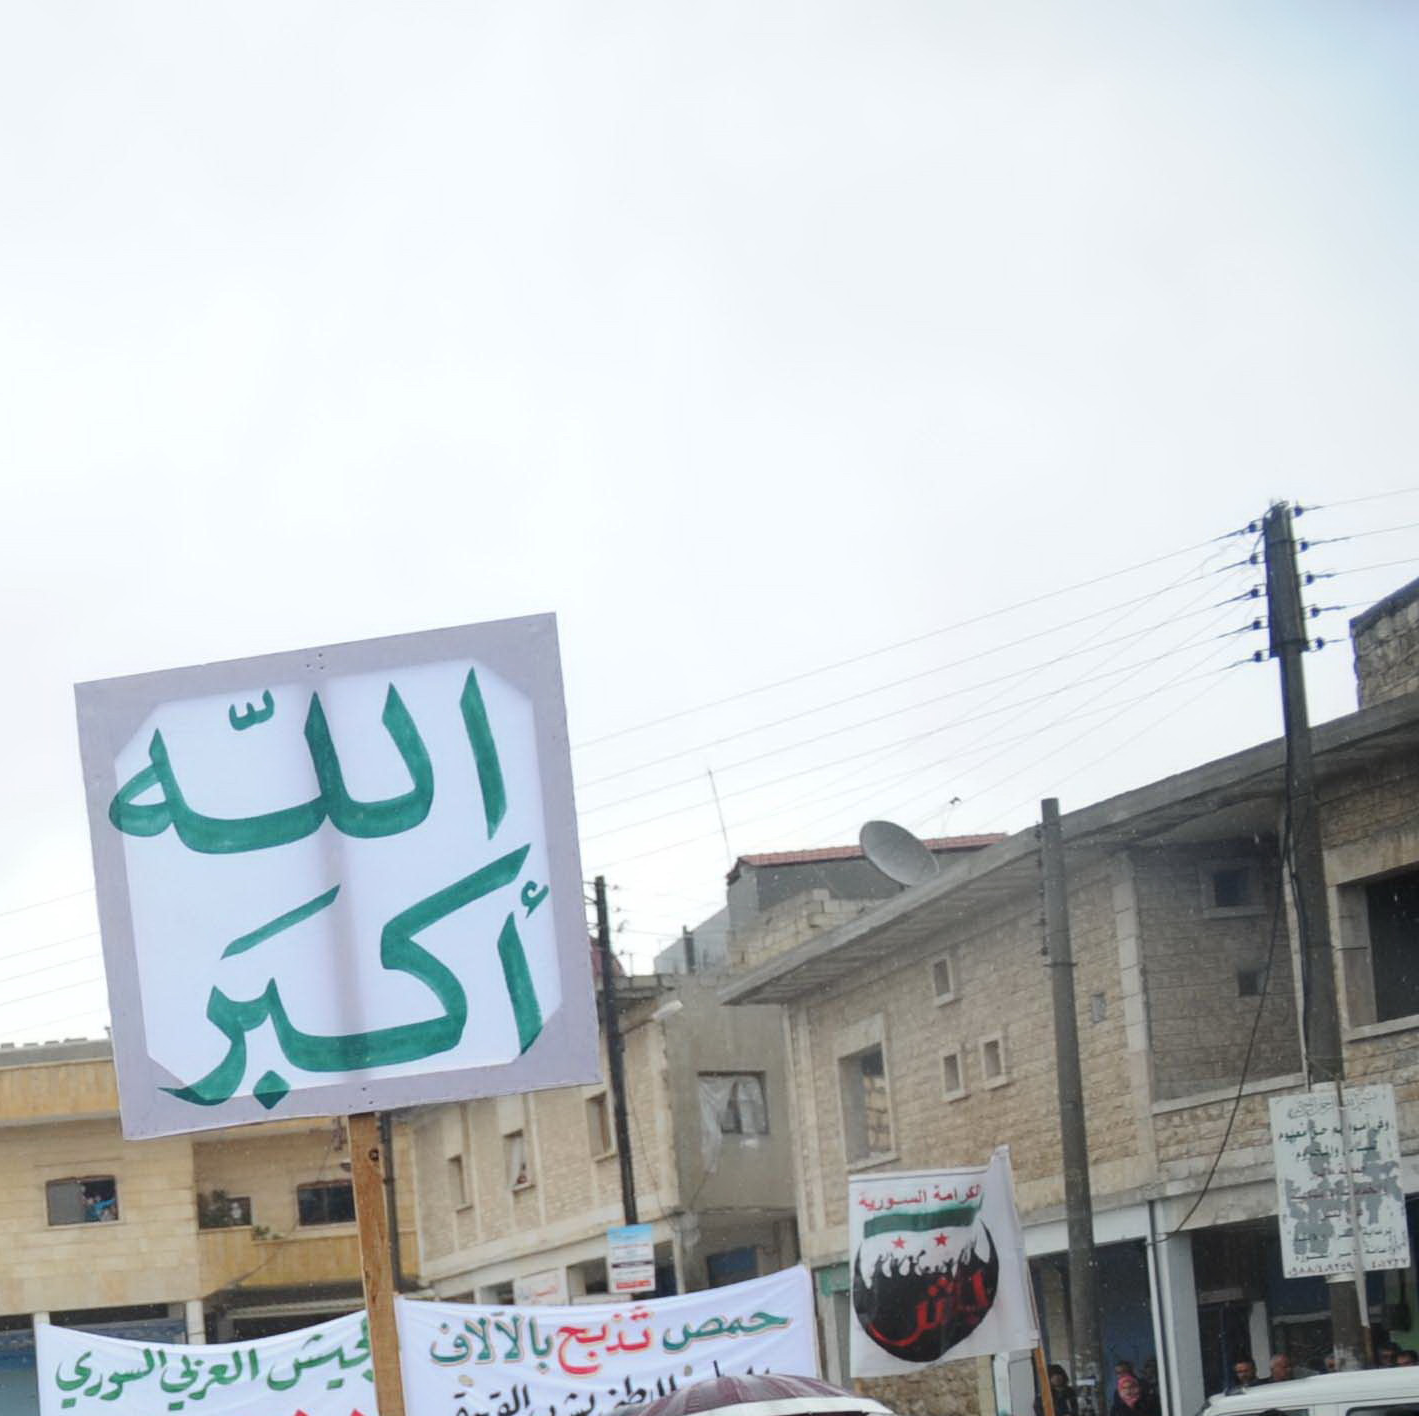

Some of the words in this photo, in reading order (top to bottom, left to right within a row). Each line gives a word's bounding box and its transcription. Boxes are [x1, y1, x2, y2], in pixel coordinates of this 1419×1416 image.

[108, 665, 507, 855] الله
[156, 842, 549, 1110] أكبر
[859, 1188, 927, 1212] السورية
[932, 1184, 982, 1204] لكرامة
[556, 1305, 652, 1376] تذبح
[664, 1306, 792, 1353] حمص
[55, 1347, 167, 1409] السوري
